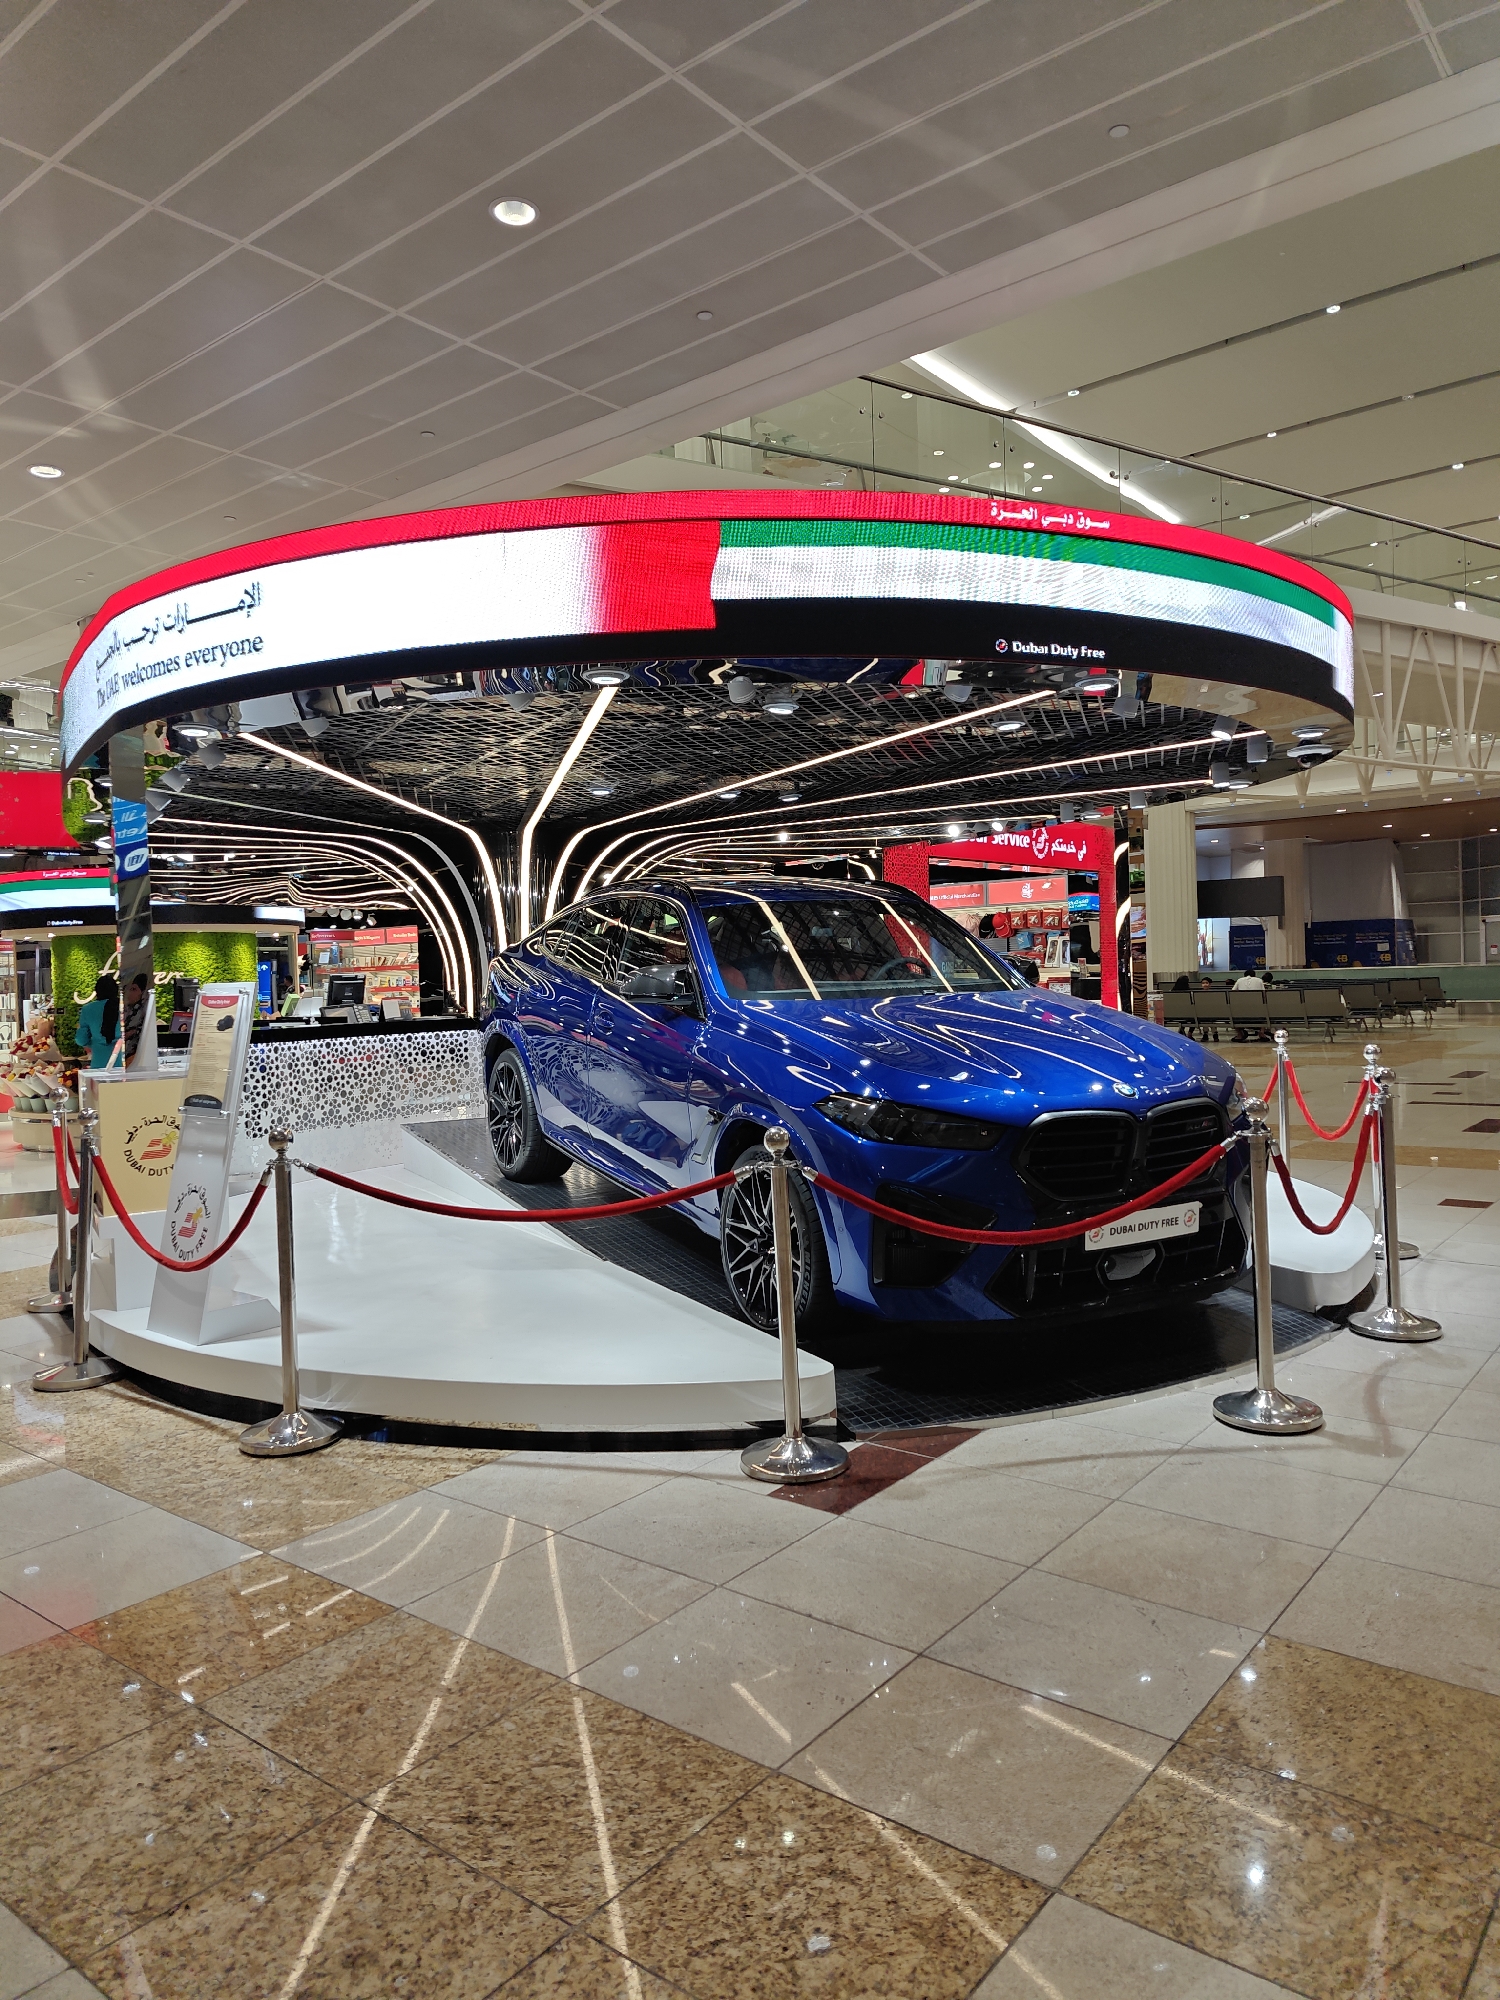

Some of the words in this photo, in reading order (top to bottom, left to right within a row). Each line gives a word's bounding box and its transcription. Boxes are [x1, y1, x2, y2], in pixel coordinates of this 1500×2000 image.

[1041, 513, 1074, 528] دبي
[1076, 511, 1110, 529] سوق
[162, 581, 263, 634] الإمارات
[1012, 640, 1048, 655] Dubai
[1051, 644, 1079, 659] Duty
[1081, 646, 1106, 659] Free
[105, 672, 119, 701] UAE
[121, 655, 180, 690] welcomes
[184, 635, 264, 667] everyone
[991, 832, 1031, 848] Service
[123, 1149, 147, 1174] DUBAI
[1109, 1224, 1136, 1236] DUBAI
[1137, 1219, 1160, 1232] DUTY
[1161, 1216, 1179, 1229] FREE
[171, 1221, 180, 1253] DUBAI
[178, 1249, 194, 1261] DUTY
[195, 1227, 208, 1253] FREE
